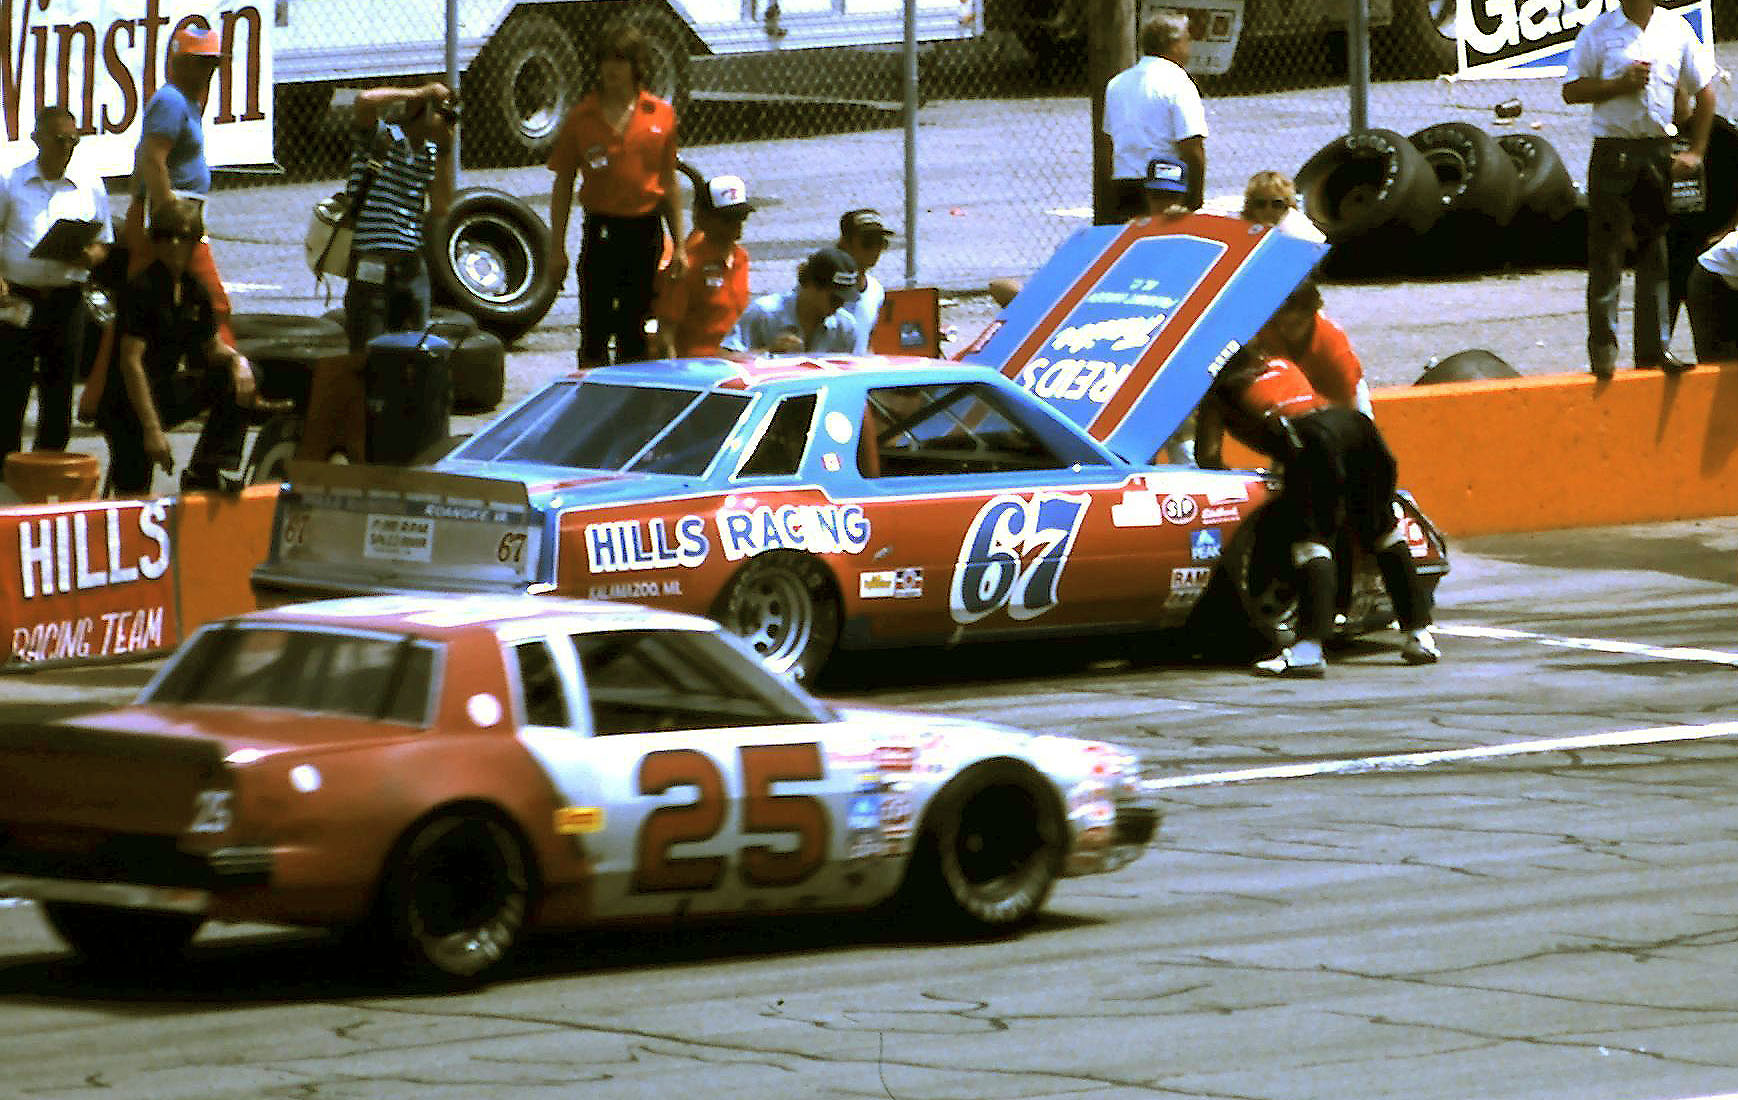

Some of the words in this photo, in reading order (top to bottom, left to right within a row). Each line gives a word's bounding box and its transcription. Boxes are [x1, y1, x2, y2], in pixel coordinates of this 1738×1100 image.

[1462, 0, 1622, 54] Gab
[19, 502, 171, 600] HILLS
[498, 531, 528, 563] 67
[585, 515, 709, 573] HILLS
[950, 493, 1092, 624] 67
[101, 606, 163, 656] TEAM
[632, 742, 829, 893] 25
